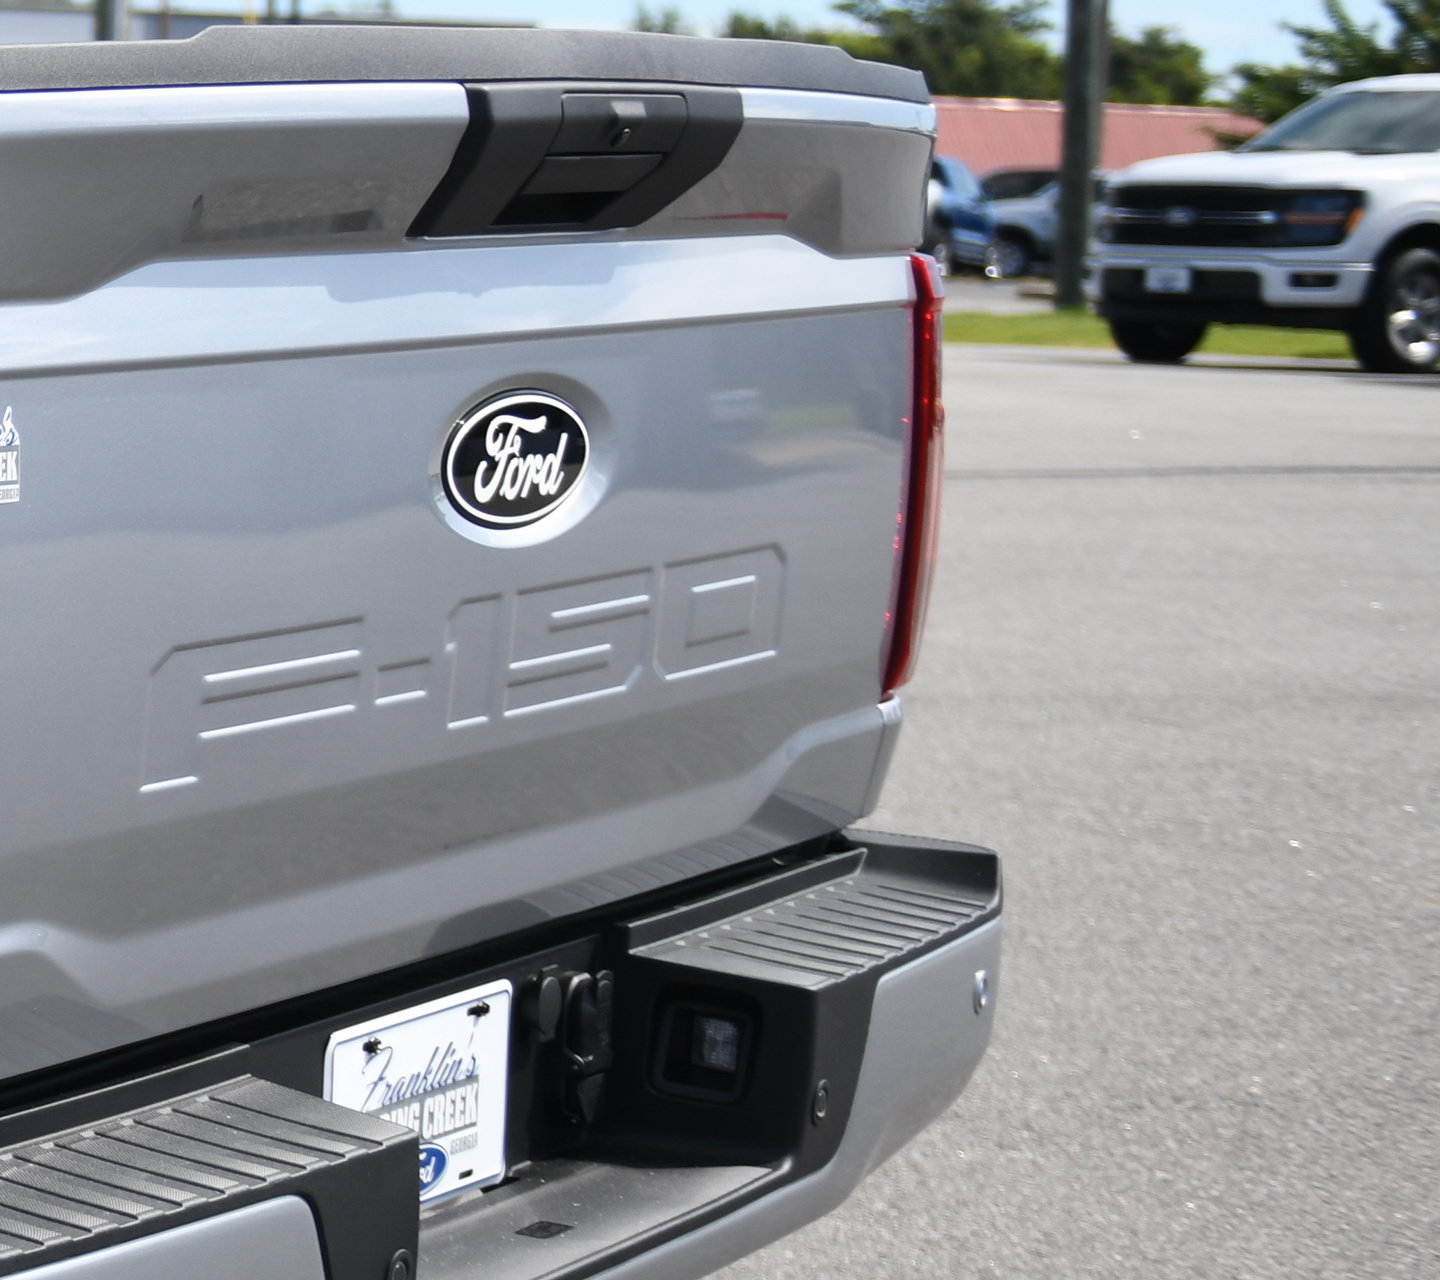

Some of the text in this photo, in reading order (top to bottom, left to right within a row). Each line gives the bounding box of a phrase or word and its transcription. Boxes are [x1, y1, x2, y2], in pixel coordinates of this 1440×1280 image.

[474, 414, 568, 502] Ford
[139, 543, 787, 792] F-150
[361, 1031, 478, 1113] Franklin's
[422, 1083, 478, 1140] CREEK
